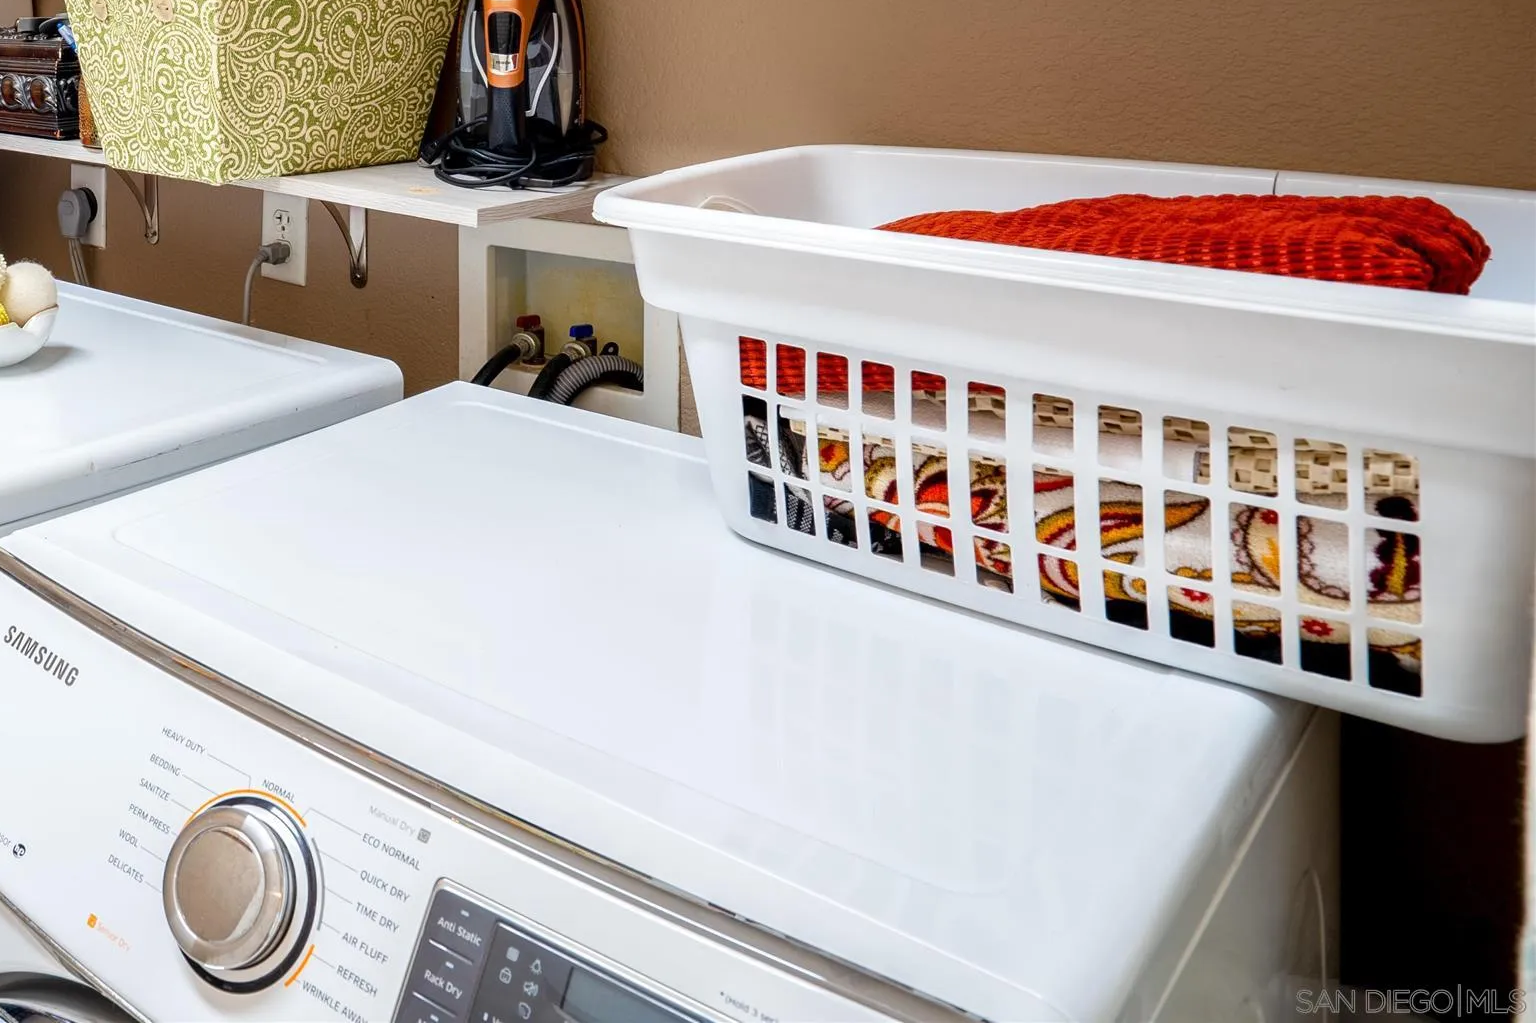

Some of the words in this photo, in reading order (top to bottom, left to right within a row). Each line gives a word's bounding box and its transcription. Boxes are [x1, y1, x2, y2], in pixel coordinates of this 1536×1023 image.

[3, 625, 80, 687] SAMSUNG
[161, 727, 186, 745] HEAVY
[185, 738, 206, 754] DUTY
[149, 753, 182, 777] BEDDING
[138, 777, 171, 802] SANITIZE
[261, 778, 296, 804] NORMAL
[127, 803, 150, 824] PERM
[147, 815, 172, 836] PRESS
[369, 804, 399, 827] Manual
[399, 817, 418, 837] Dry
[117, 828, 140, 849] WOOL
[362, 833, 381, 851] ECO
[381, 842, 421, 872] NORMAL
[107, 853, 145, 884] DELICATES
[360, 869, 391, 894] QUICK
[389, 884, 412, 904] DRY
[356, 901, 381, 922] TIME
[378, 915, 401, 935] DRY
[437, 917, 457, 933] Anti
[457, 926, 483, 947] Static
[96, 921, 120, 946] Sensor
[117, 937, 133, 953] Dry
[342, 931, 360, 949] AIR
[357, 942, 390, 966] FLUFF
[302, 980, 341, 1013] WRINKLE
[336, 964, 379, 998] REFRESH
[423, 969, 446, 989] Rack
[444, 981, 463, 1000] Dry
